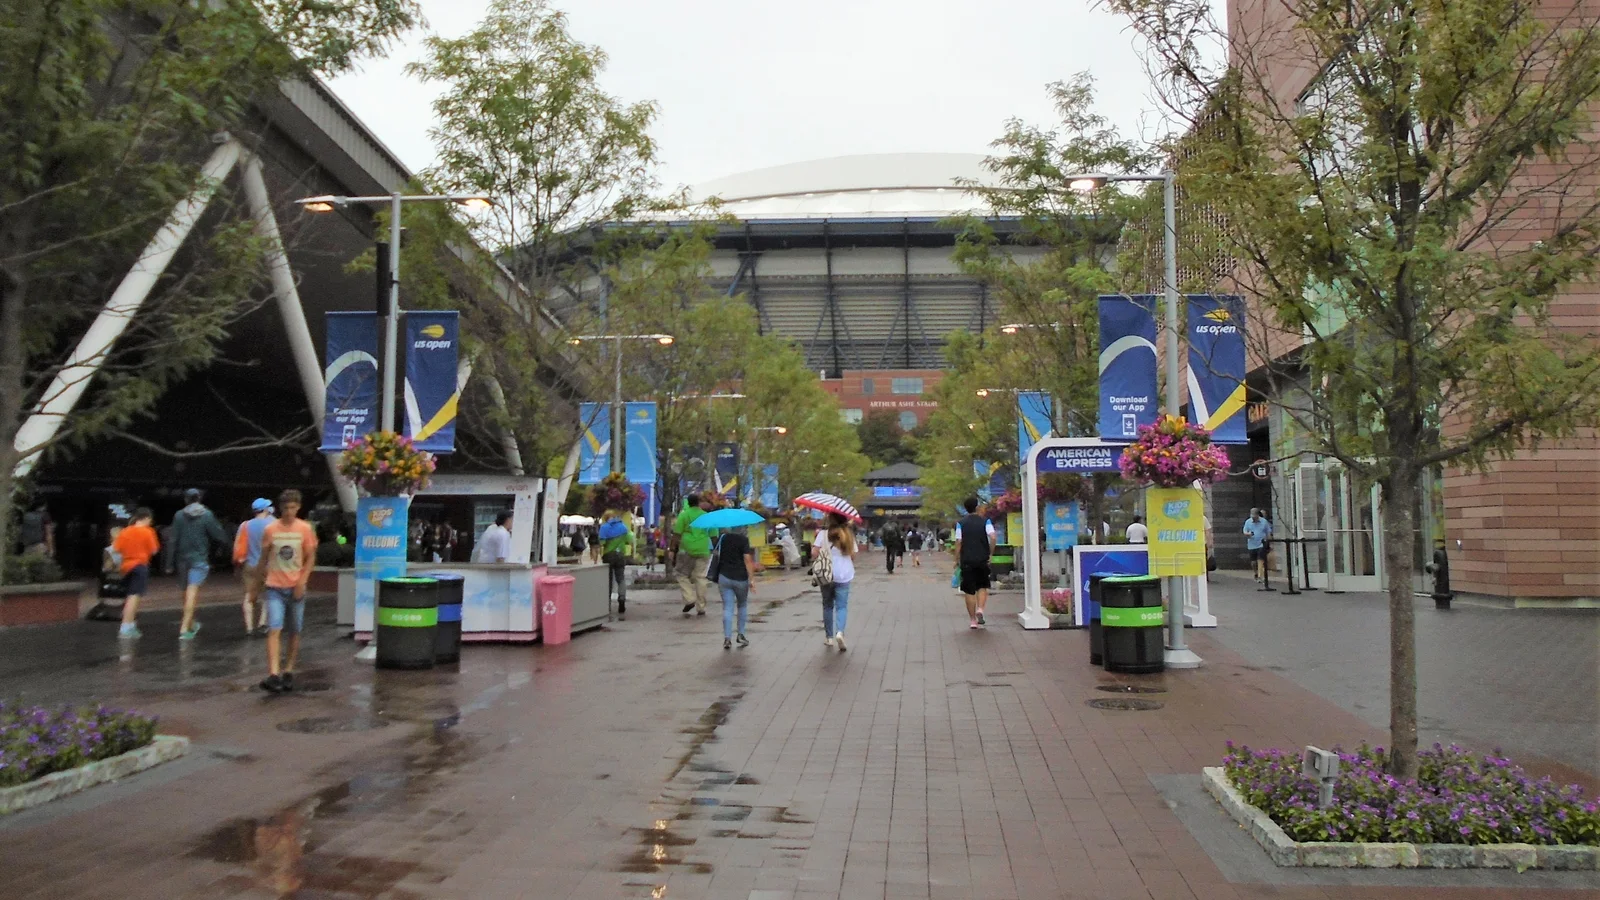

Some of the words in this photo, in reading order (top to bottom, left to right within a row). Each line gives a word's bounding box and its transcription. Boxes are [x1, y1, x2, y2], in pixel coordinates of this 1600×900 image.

[1195, 325, 1209, 333] us
[1209, 325, 1236, 336] open
[415, 340, 427, 349] us
[426, 340, 451, 351] open
[1128, 403, 1145, 412] App
[349, 416, 365, 424] App
[1046, 448, 1111, 459] AMERICAN
[1056, 458, 1112, 468] EXPRESS
[1158, 529, 1198, 542] WELCOME
[362, 535, 401, 548] WELCOME
